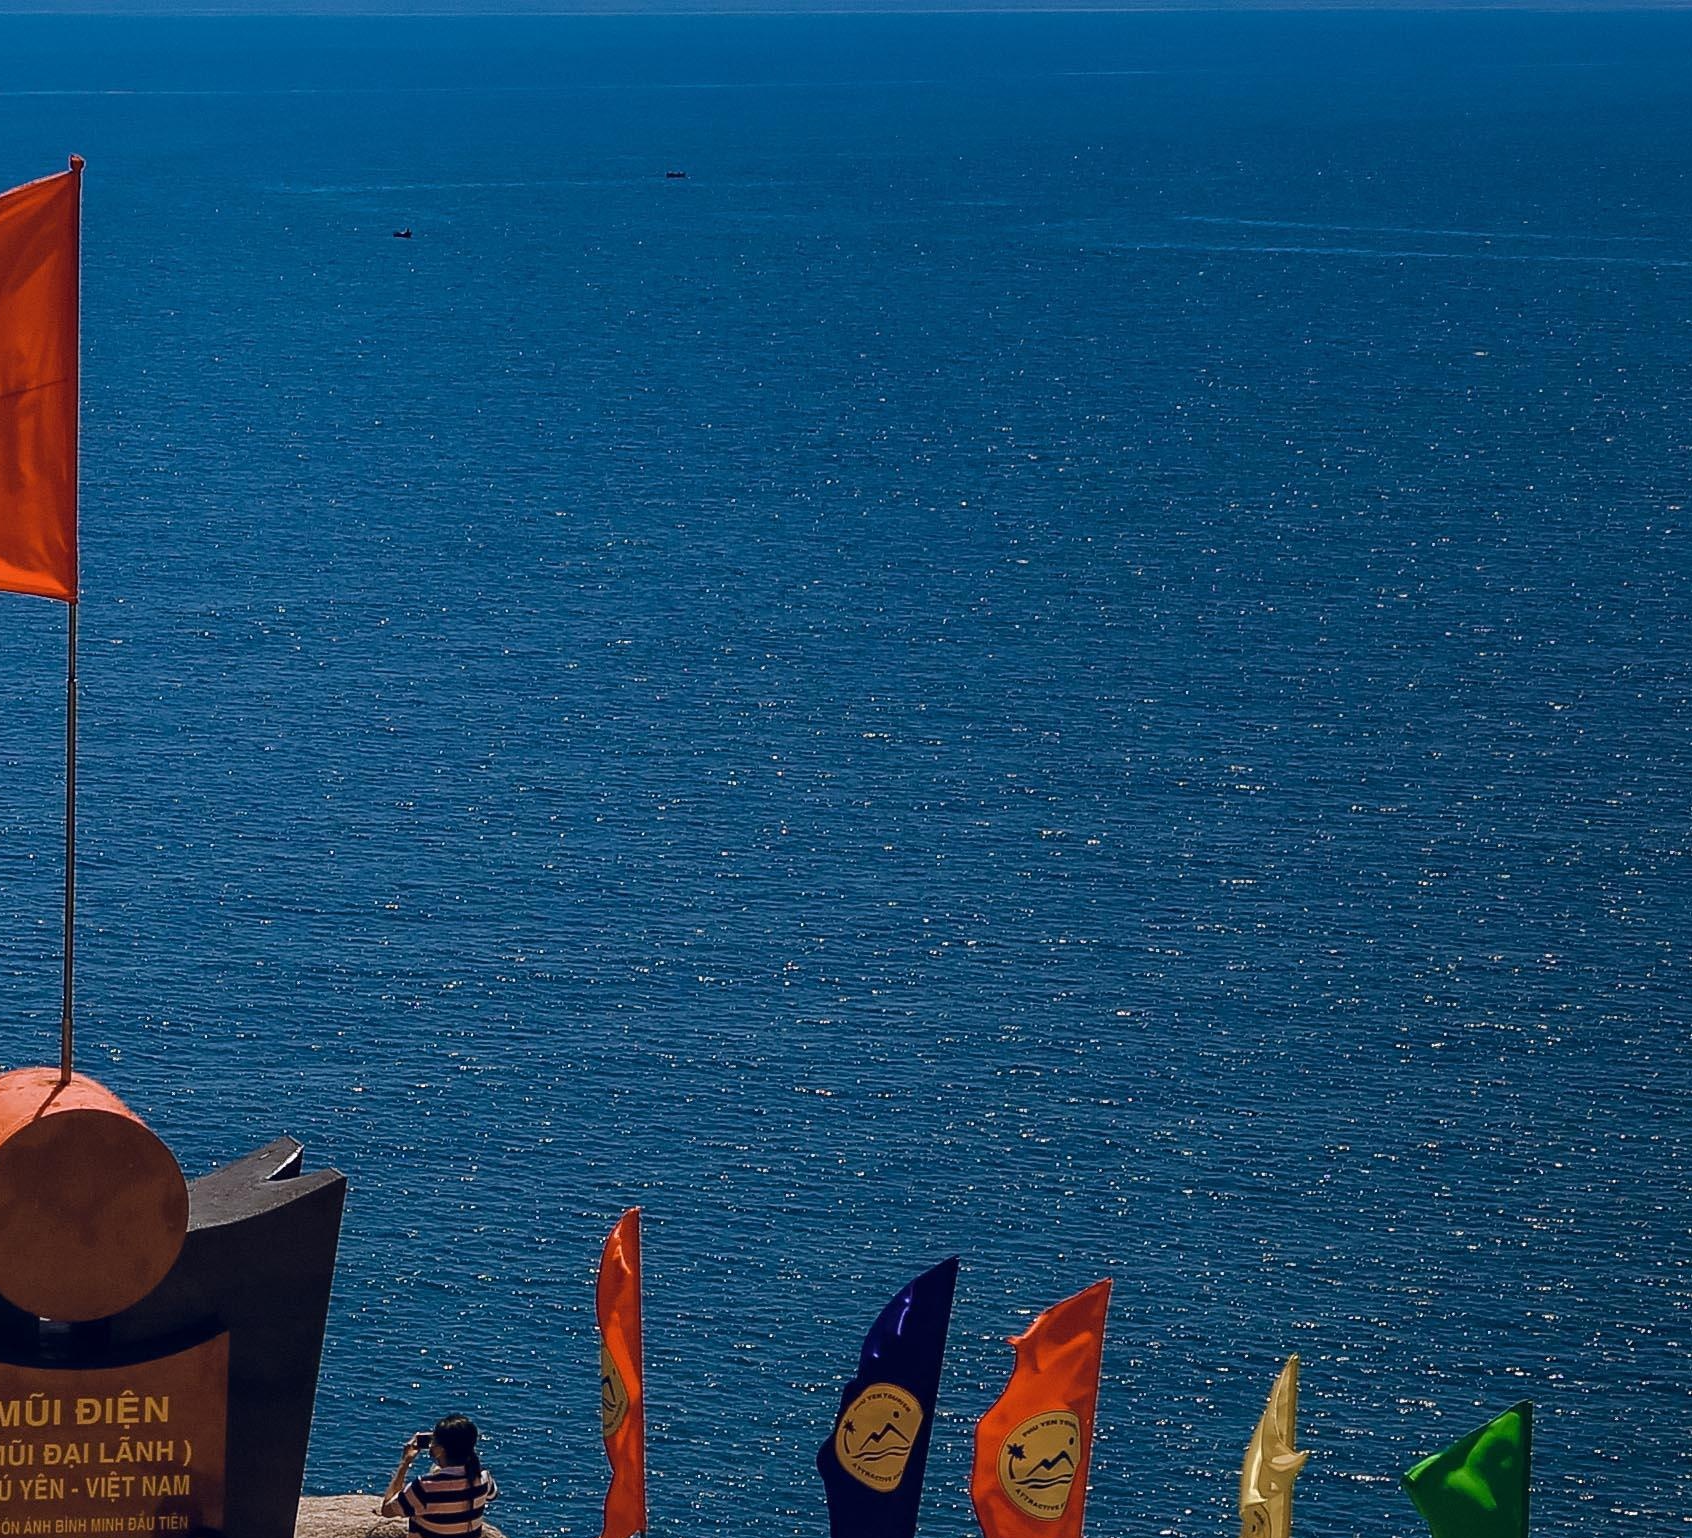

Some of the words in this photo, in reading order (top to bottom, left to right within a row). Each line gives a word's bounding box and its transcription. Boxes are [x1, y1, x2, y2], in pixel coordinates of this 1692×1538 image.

[75, 1390, 169, 1429] ĐIỆN
[43, 1442, 90, 1469] ĐẠI
[99, 1436, 174, 1464] LÃNH
[19, 1473, 65, 1500] YÊN
[86, 1471, 136, 1503] VIỆT
[142, 1474, 191, 1497] NAM
[1015, 1487, 1060, 1511] ATTRACTIVE
[91, 1517, 124, 1533] MINH
